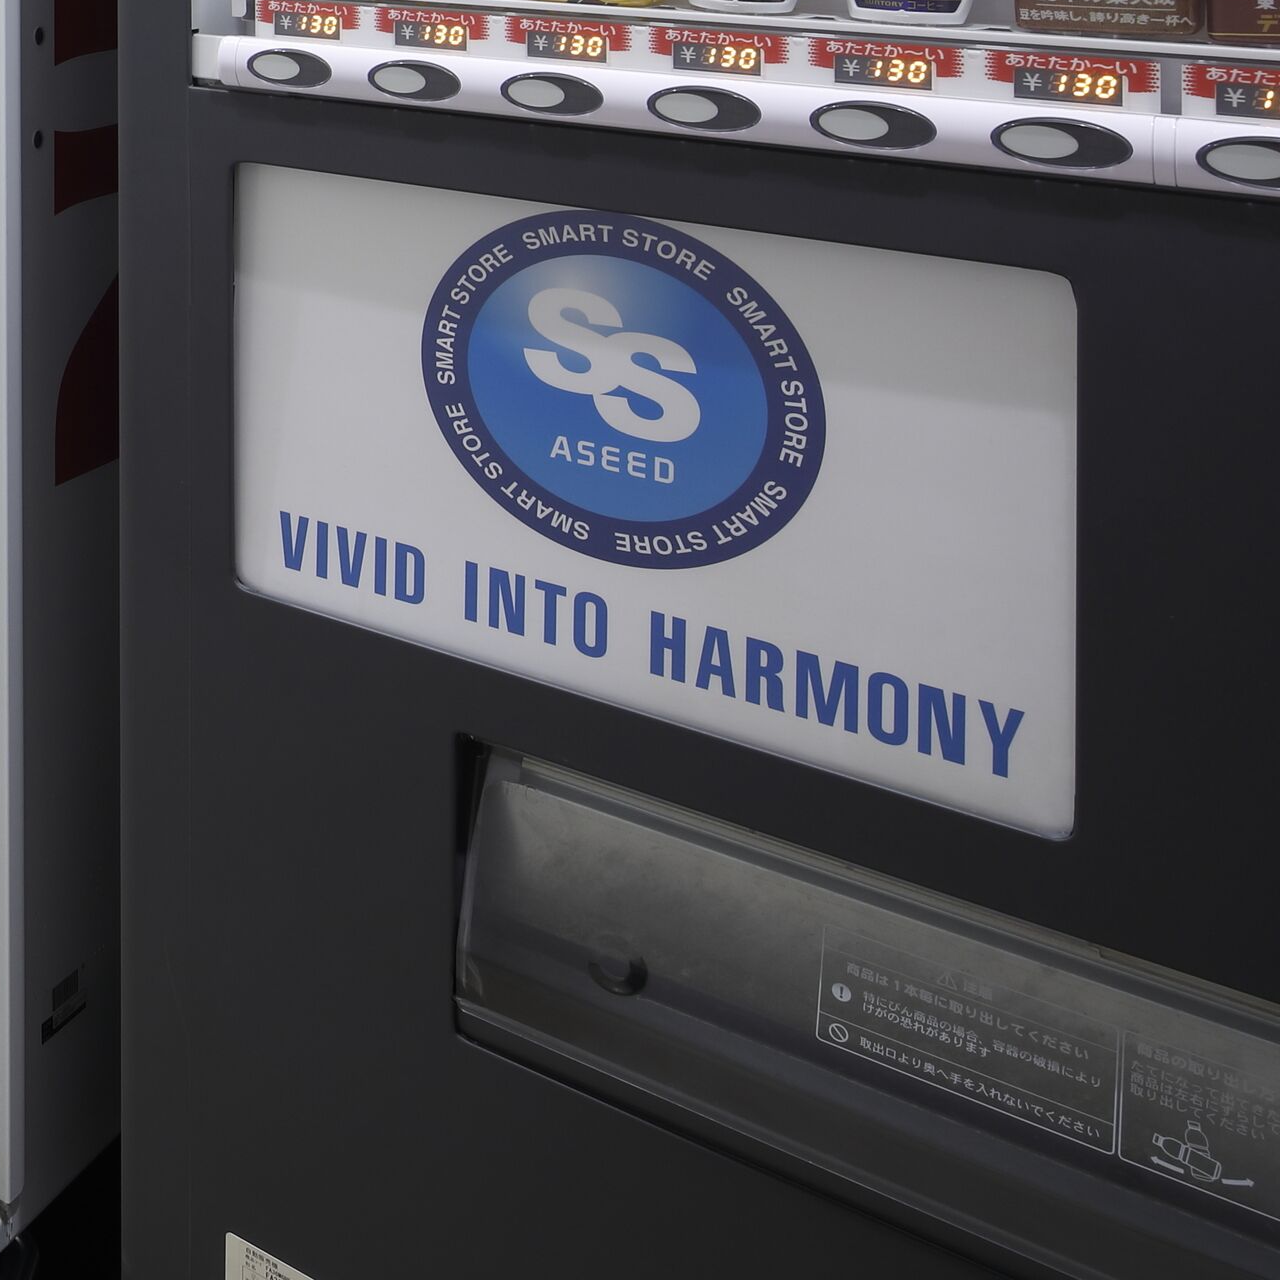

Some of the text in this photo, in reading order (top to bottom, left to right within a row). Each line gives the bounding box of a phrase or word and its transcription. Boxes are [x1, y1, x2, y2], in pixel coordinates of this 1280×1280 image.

[865, 0, 903, 8] SUNTORY
[434, 244, 514, 386] SMART STORE
[521, 224, 716, 282] SMART STORE
[522, 286, 702, 444] SS
[725, 284, 808, 469] SMART STORE
[446, 402, 591, 542] SMART STORE
[549, 435, 676, 485] ASEED
[614, 481, 788, 555] SMART STORE
[278, 511, 1025, 780] VIVID INTO HARMONY
